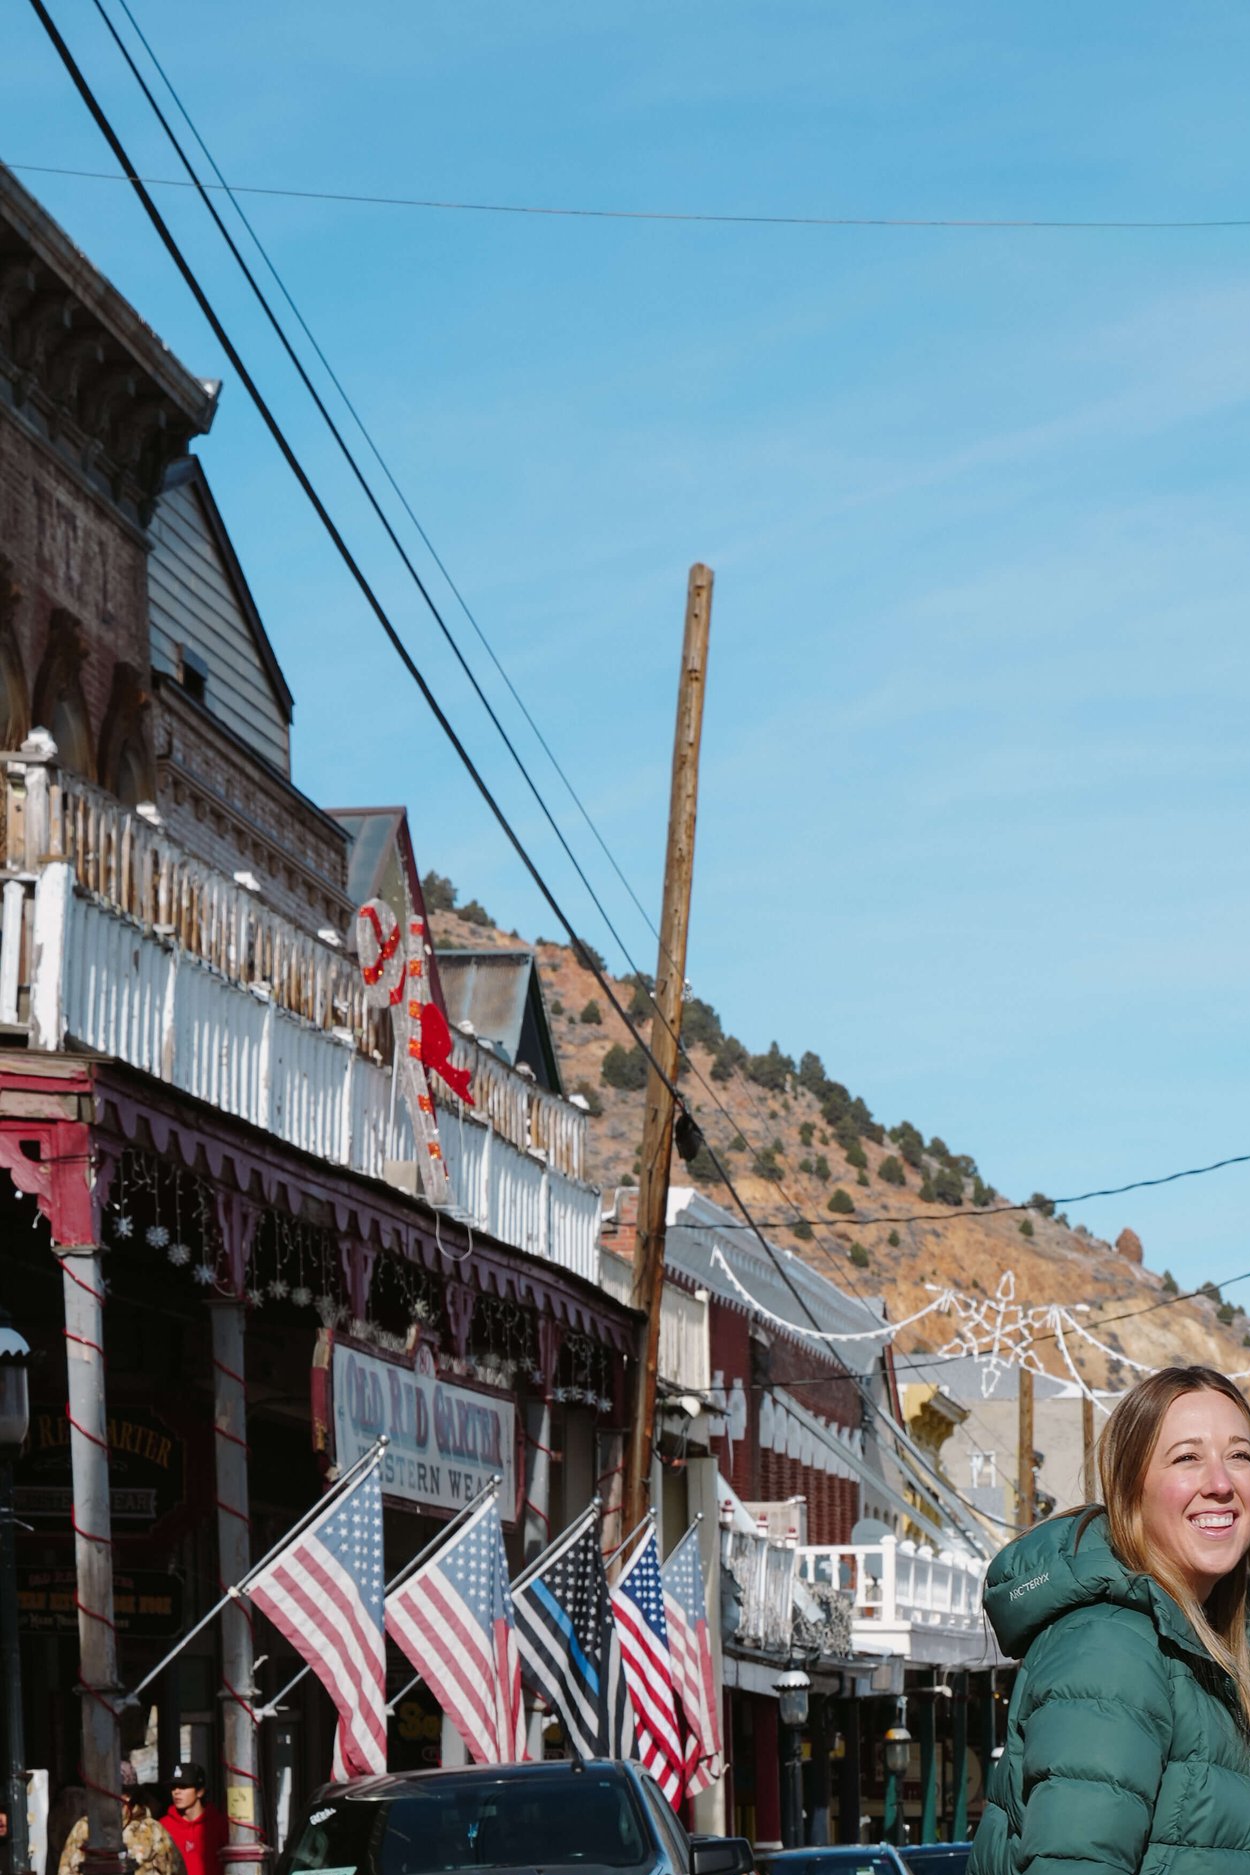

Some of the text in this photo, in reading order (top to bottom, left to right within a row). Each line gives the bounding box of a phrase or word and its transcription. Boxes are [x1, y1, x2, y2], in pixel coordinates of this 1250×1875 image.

[347, 1354, 504, 1471] OLD RED GARTER
[108, 1418, 172, 1469] ARTER
[357, 1445, 501, 1506] STERN WEA
